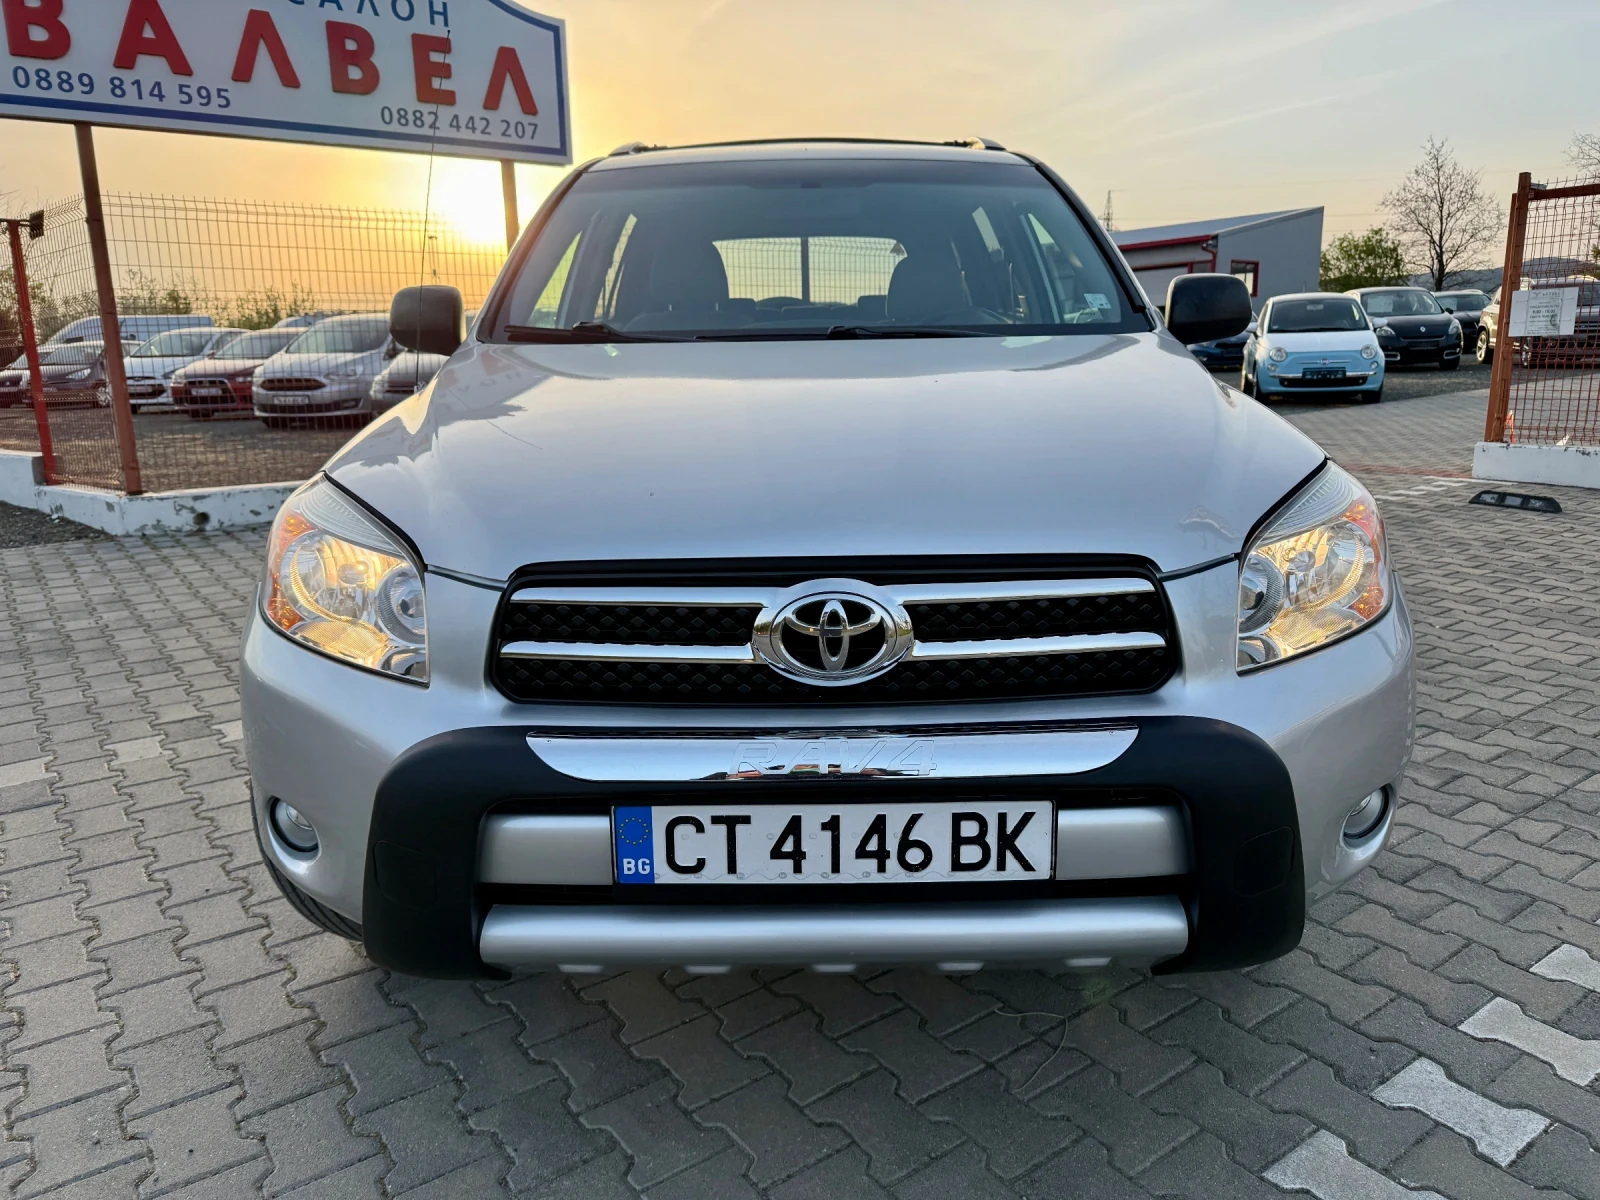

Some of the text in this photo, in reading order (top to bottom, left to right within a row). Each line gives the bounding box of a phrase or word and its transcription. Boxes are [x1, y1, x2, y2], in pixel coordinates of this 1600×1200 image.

[12, 65, 231, 109] 0889 814 595
[380, 105, 539, 140] 0882 442 207
[727, 739, 938, 776] RAV4
[769, 812, 934, 874] 4146
[622, 857, 651, 875] BG
